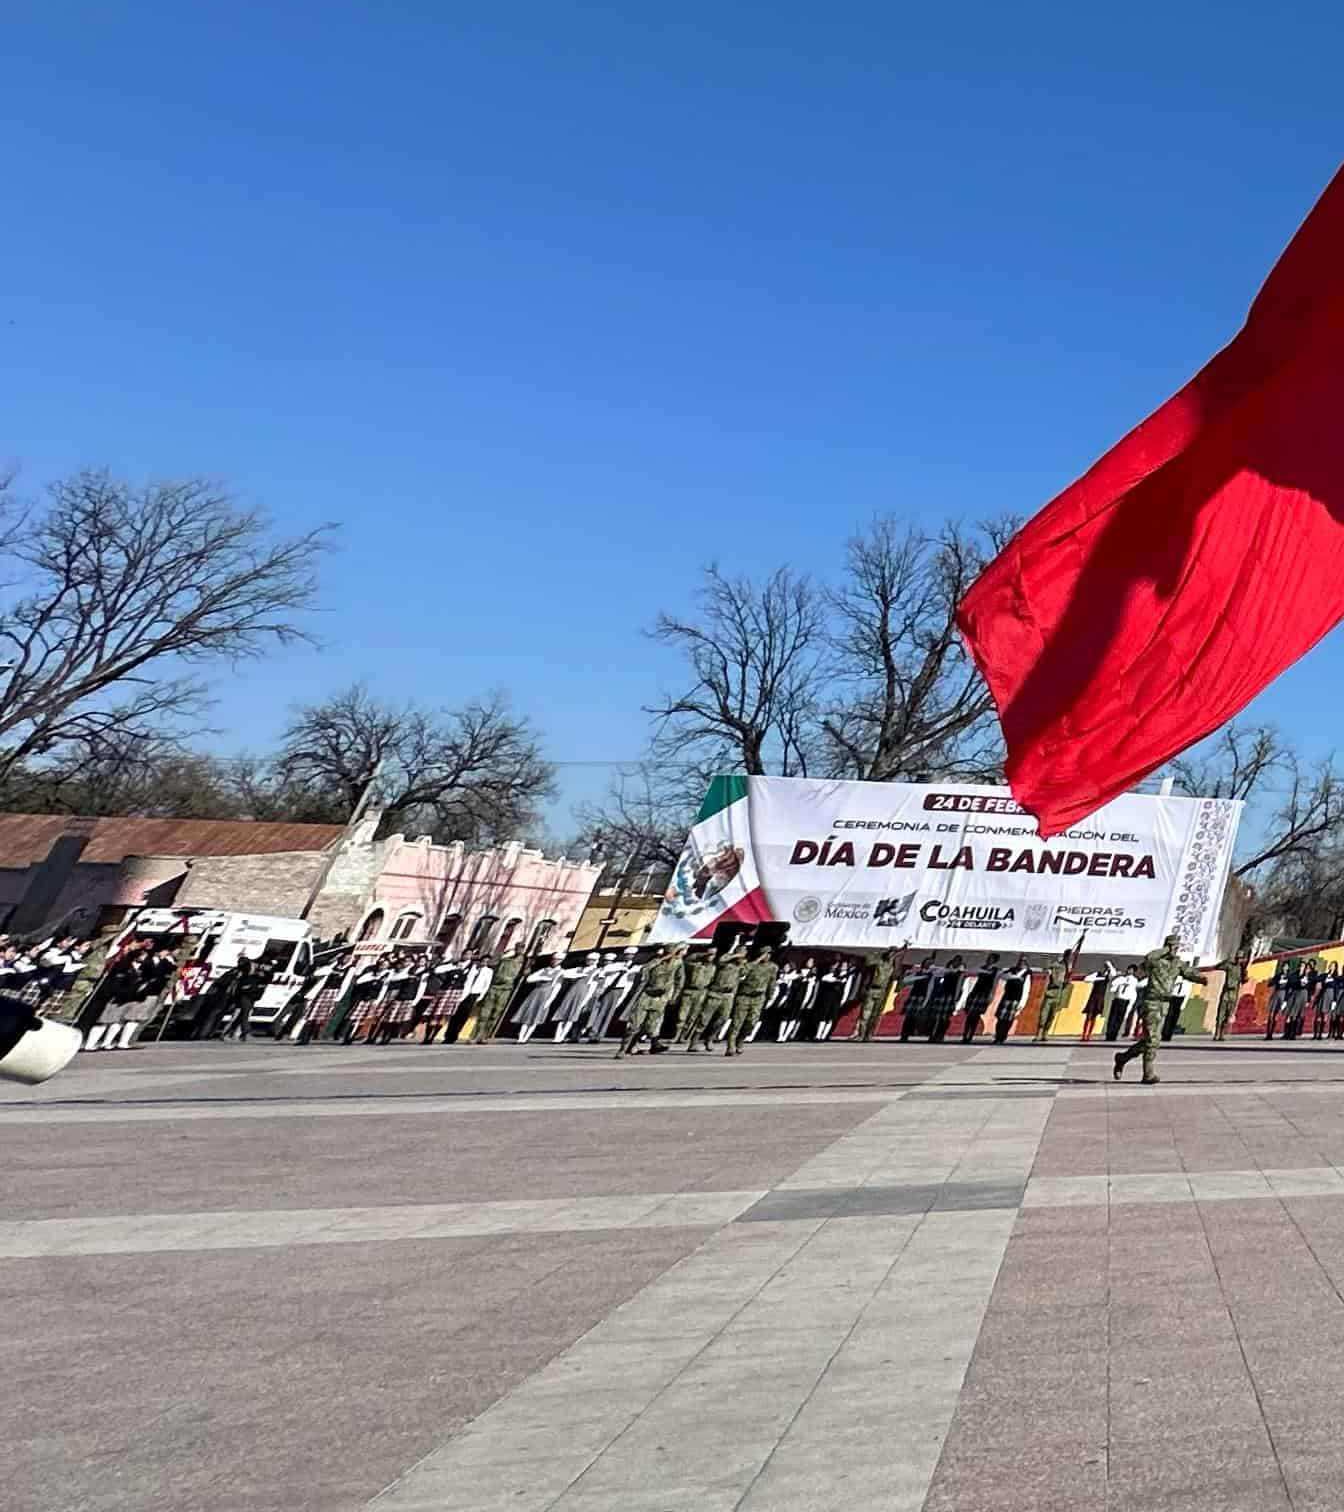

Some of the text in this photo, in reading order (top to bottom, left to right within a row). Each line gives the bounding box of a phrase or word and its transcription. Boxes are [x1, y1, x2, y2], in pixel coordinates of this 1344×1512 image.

[933, 796, 954, 809] 24
[957, 797, 983, 811] DE
[833, 819, 1139, 842] CEREMONIA DE CONMEMACIÓN DEL
[789, 835, 1156, 879] DÍA DE LA BANDERA
[919, 900, 1014, 922] COAHUILA
[1056, 905, 1125, 916] PIEDRAS
[1053, 916, 1146, 928] NEGRAS
